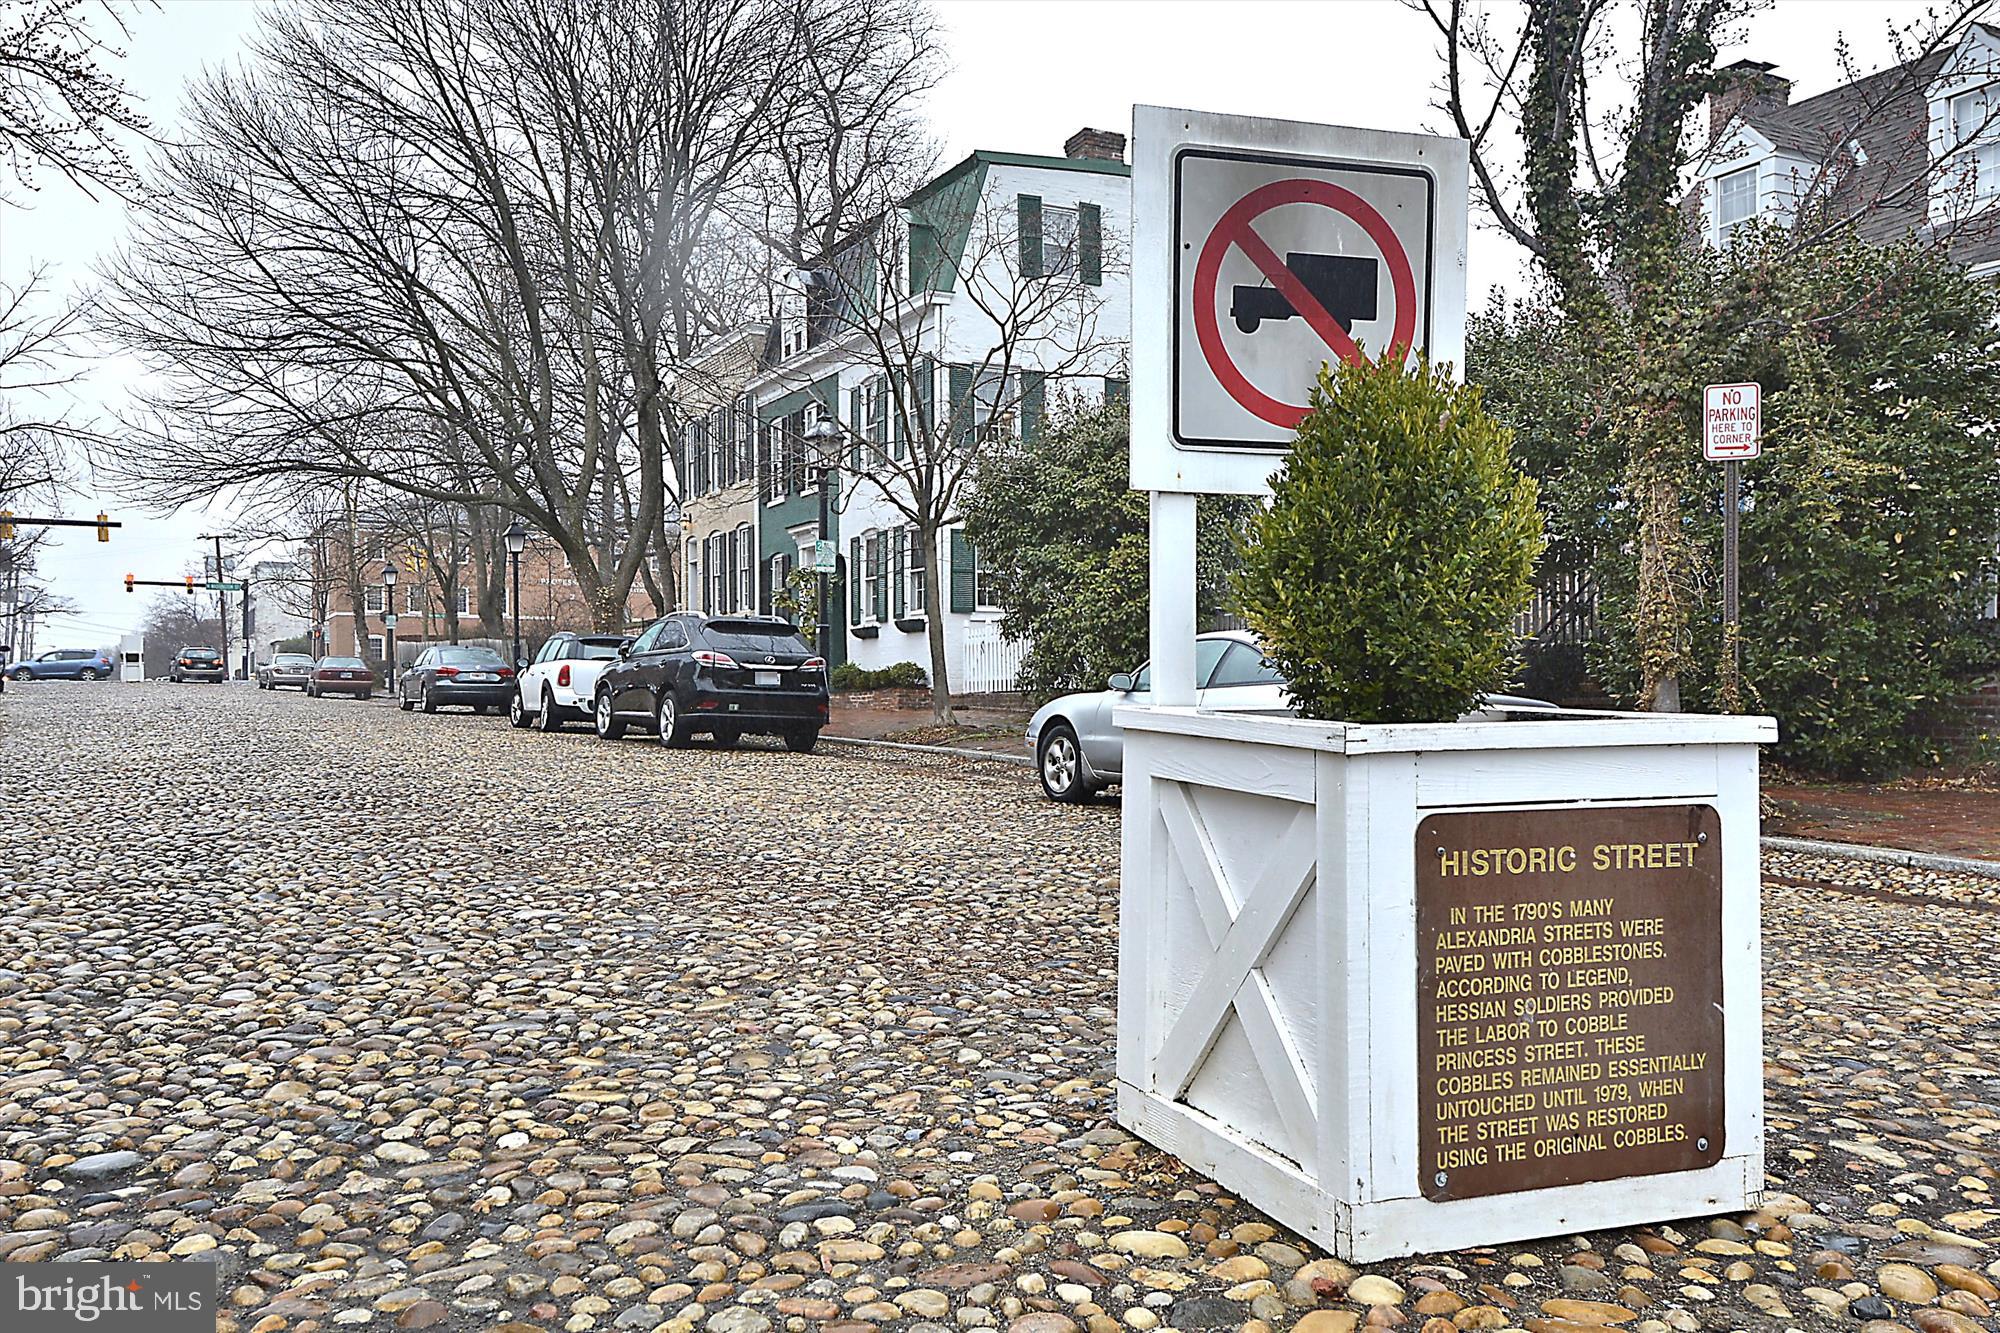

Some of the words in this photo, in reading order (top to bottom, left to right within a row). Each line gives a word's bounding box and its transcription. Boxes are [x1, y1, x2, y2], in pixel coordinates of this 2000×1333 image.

[1709, 407, 1755, 422] PARKING
[1722, 391, 1741, 405] NO
[1711, 423, 1736, 432] HERE
[1742, 422, 1752, 431] TO
[1713, 433, 1751, 444] CORNER
[1441, 845, 1576, 876] HISTORIC
[1592, 842, 1698, 870] STREET
[1450, 906, 1465, 925] IN
[1472, 904, 1504, 923] THE
[1511, 900, 1562, 920] 1790'S
[1569, 897, 1614, 917] MANY
[1435, 926, 1536, 950] ALEXANDRIA
[1543, 920, 1613, 942] STREETS
[1619, 917, 1664, 937] WERE
[1435, 953, 1485, 974] PAVED
[1491, 949, 1532, 969] WITH
[1539, 940, 1667, 966] COBBLESTONES.
[1435, 973, 1532, 998] ACCORDING
[1538, 971, 1559, 989] TO
[1567, 966, 1632, 987] LEGEND,
[1435, 999, 1505, 1023] HESSIAN
[1513, 992, 1591, 1017] SOLDIERS
[1598, 986, 1674, 1008] PROVIDED
[1435, 1026, 1468, 1047] THE
[1475, 1019, 1530, 1043] LABOR
[1536, 1018, 1558, 1037] TO
[1564, 1012, 1628, 1035] COBBLE
[1436, 1046, 1516, 1071] PRINCESS
[1524, 1040, 1588, 1062] STREET.
[1594, 1034, 1645, 1056] THESE
[1436, 1070, 1513, 1096] COBBLES
[1520, 1062, 1601, 1087] REMAINED
[1608, 1052, 1706, 1078] ESSENTIALLY
[1436, 1092, 1535, 1120] UNTOUCHED
[1542, 1087, 1587, 1108] UNTIL
[1593, 1082, 1631, 1103] 1979,
[1637, 1077, 1683, 1098] WHEN
[1436, 1123, 1469, 1144] THE
[1476, 1116, 1538, 1140] STREET
[1544, 1111, 1579, 1132] WAS
[1586, 1102, 1667, 1127] RESTORED
[1436, 1146, 1487, 1169] USING
[1494, 1141, 1526, 1162] THE
[1533, 1132, 1607, 1157] ORIGINAL
[1613, 1123, 1688, 1148] COBBLES.
